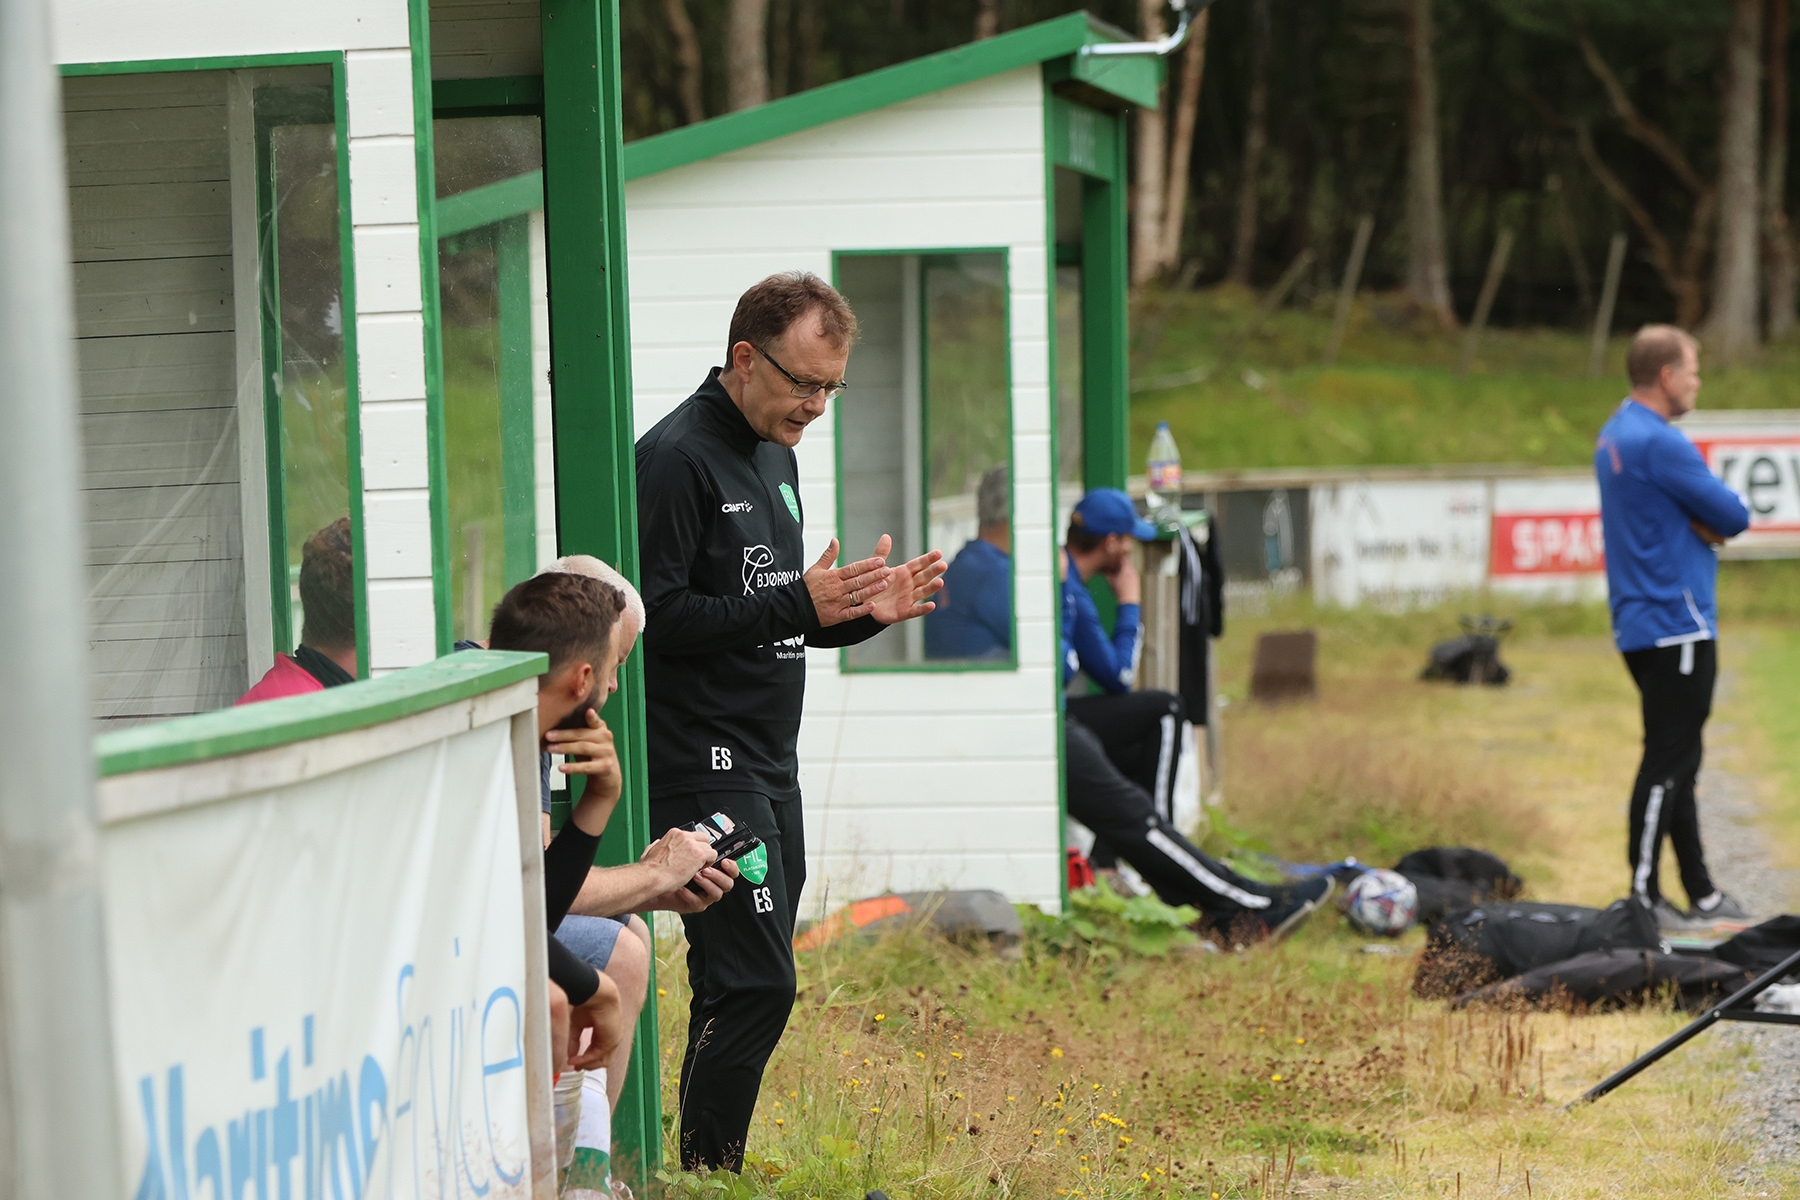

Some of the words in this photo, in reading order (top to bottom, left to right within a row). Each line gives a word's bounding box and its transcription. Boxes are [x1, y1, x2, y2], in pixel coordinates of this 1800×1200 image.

[721, 503, 746, 514] CRAFT
[711, 746, 733, 770] ES
[752, 886, 774, 914] ES
